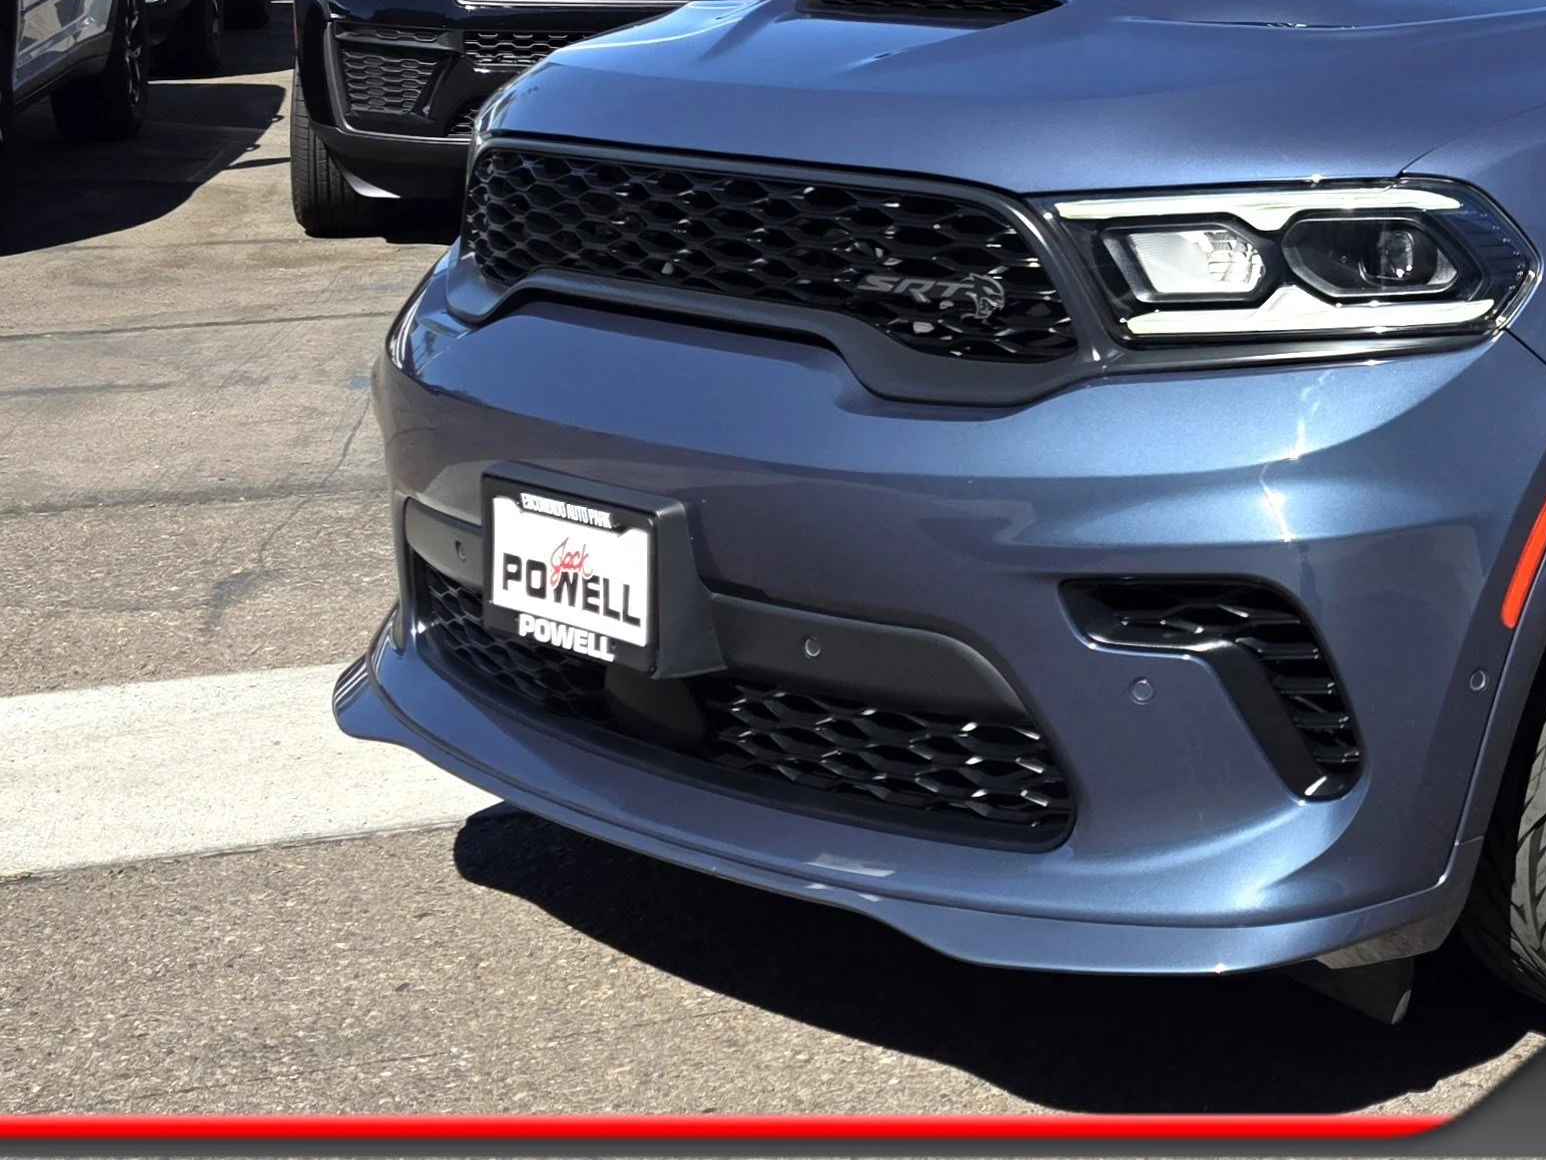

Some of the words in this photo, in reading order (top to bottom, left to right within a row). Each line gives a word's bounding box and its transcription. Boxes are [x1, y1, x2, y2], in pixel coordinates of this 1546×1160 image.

[857, 275, 975, 304] SRT
[550, 536, 594, 587] Jack
[502, 552, 642, 628] POWELL
[518, 613, 616, 662] POWELL
